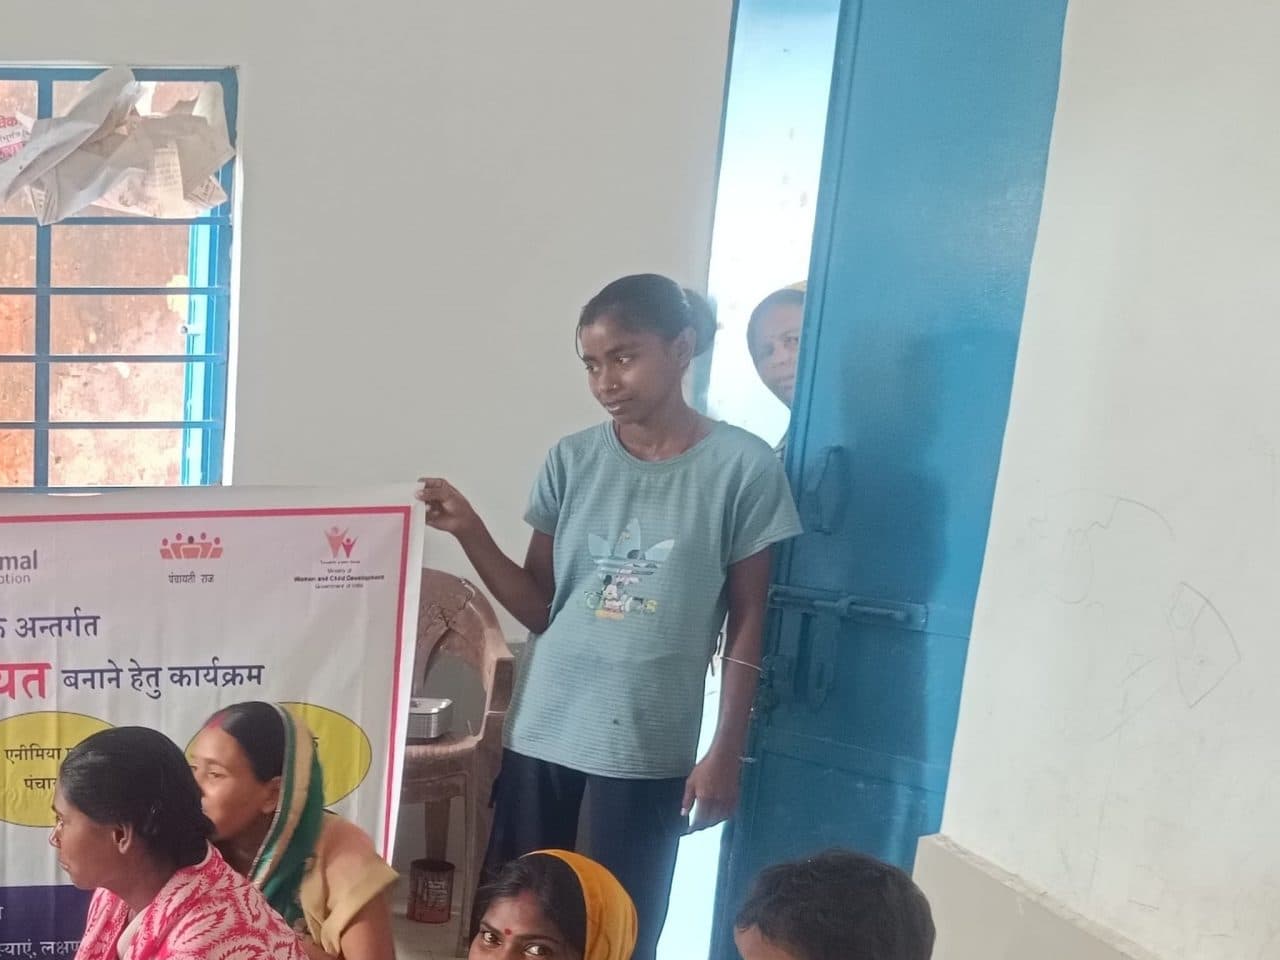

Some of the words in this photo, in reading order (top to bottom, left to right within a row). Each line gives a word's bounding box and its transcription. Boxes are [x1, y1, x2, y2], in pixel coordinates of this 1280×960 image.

[15, 606, 101, 639] अन्तर्गत
[61, 658, 123, 691] बनाने
[128, 658, 162, 699] हेतु
[169, 658, 266, 687] कार्यक्रम
